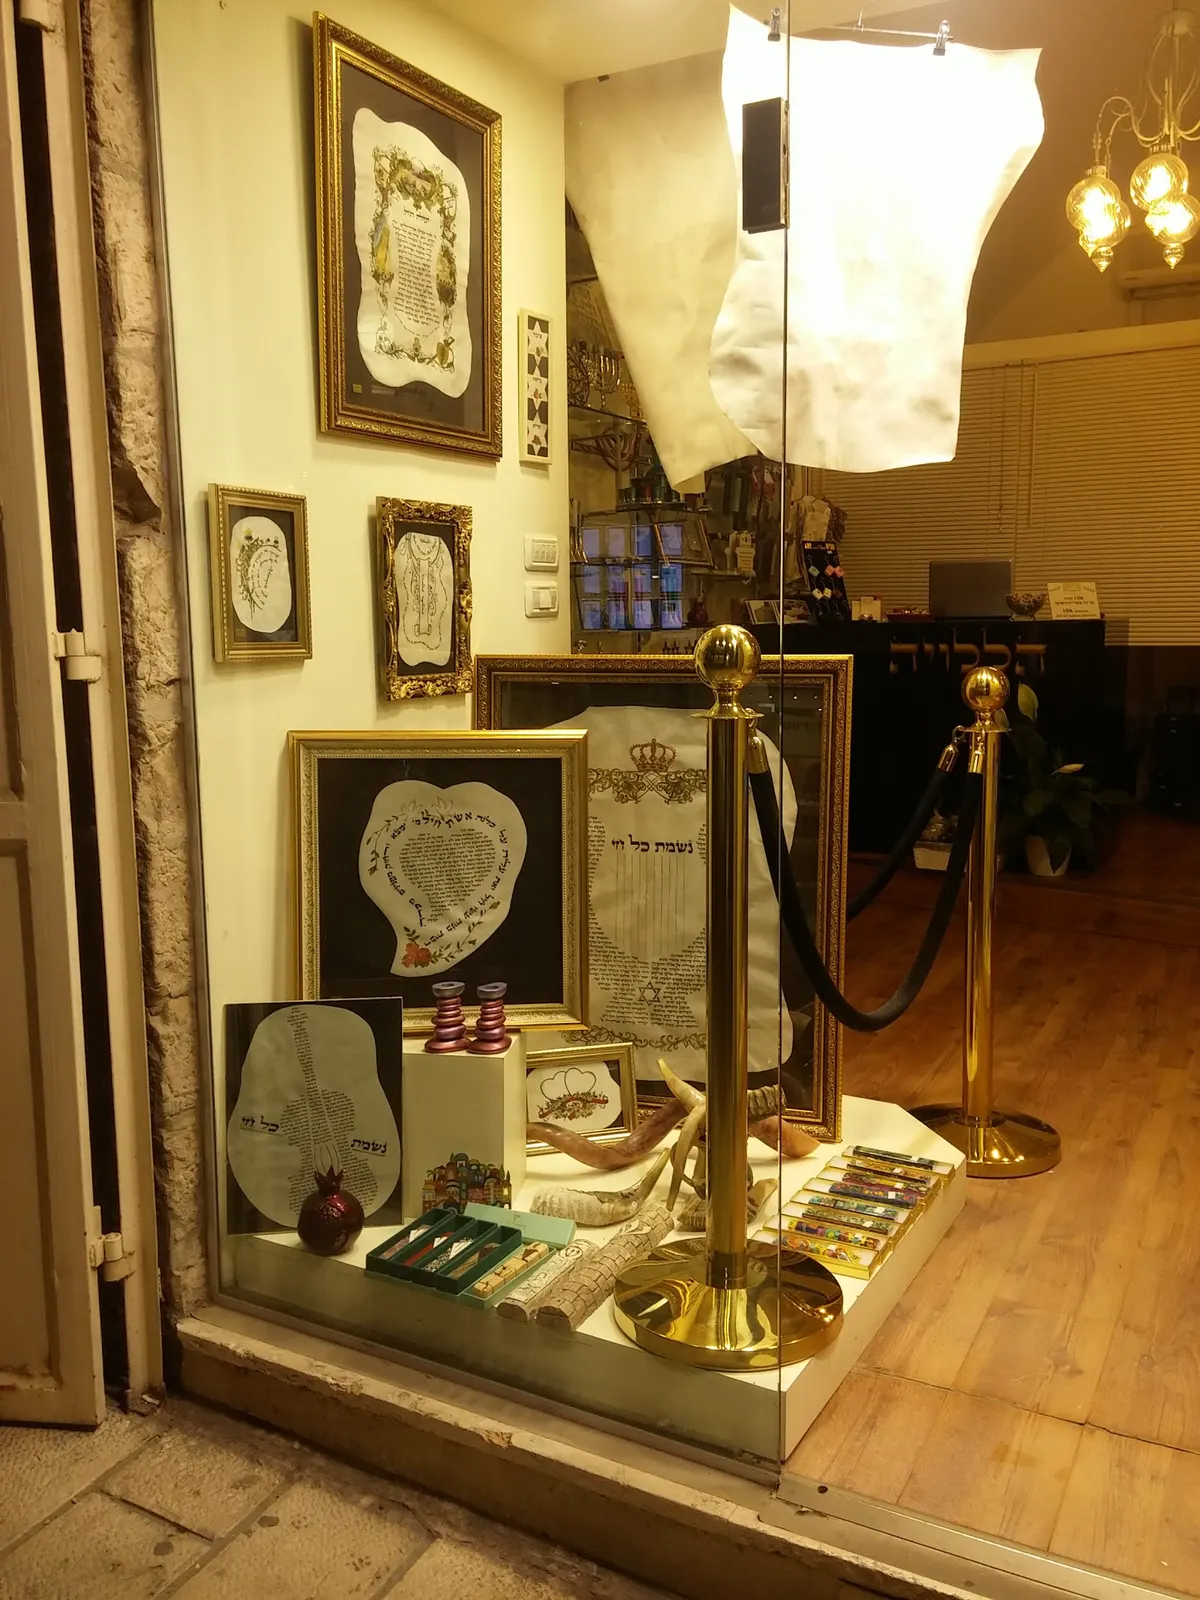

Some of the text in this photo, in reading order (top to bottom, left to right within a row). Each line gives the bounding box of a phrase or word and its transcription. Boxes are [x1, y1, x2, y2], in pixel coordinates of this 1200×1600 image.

[889, 628, 1047, 676] הללויה
[421, 811, 441, 828] חיל
[445, 812, 472, 828] אשת
[391, 823, 406, 839] ימצא
[611, 834, 694, 854] נשמת כל חי
[424, 930, 444, 947] רבות
[446, 918, 463, 932] בנות
[241, 1115, 388, 1154] נשמת כל חי
